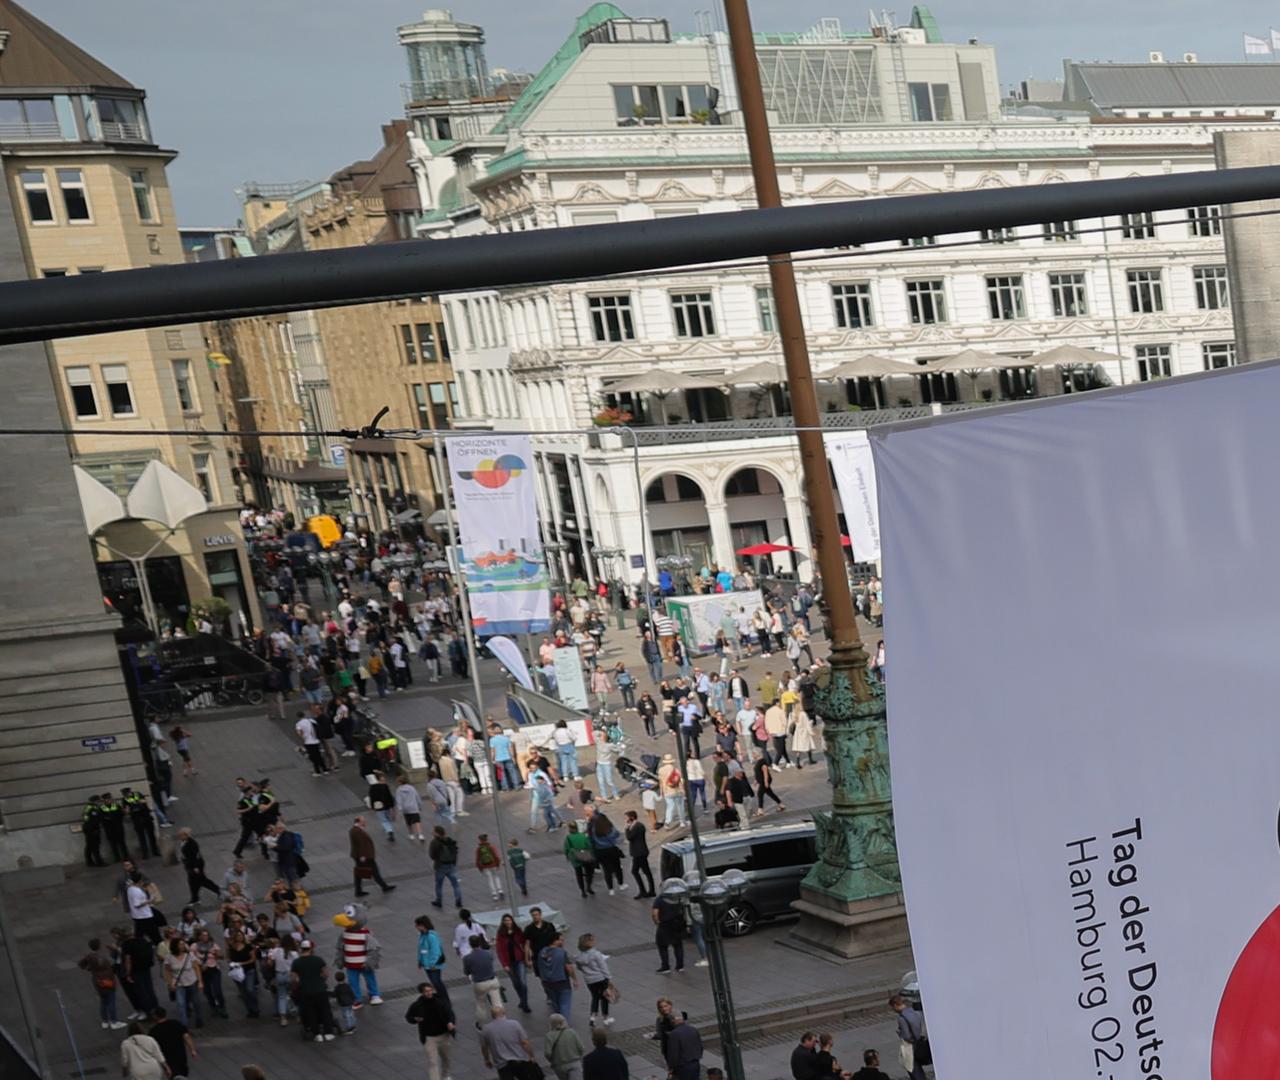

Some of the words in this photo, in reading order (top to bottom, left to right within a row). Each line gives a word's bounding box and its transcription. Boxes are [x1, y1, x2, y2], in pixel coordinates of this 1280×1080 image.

[450, 439, 508, 448] HORIZONTE
[1107, 816, 1143, 887] Tag
[1065, 835, 1109, 1010] Hamburg
[1118, 893, 1150, 954] der
